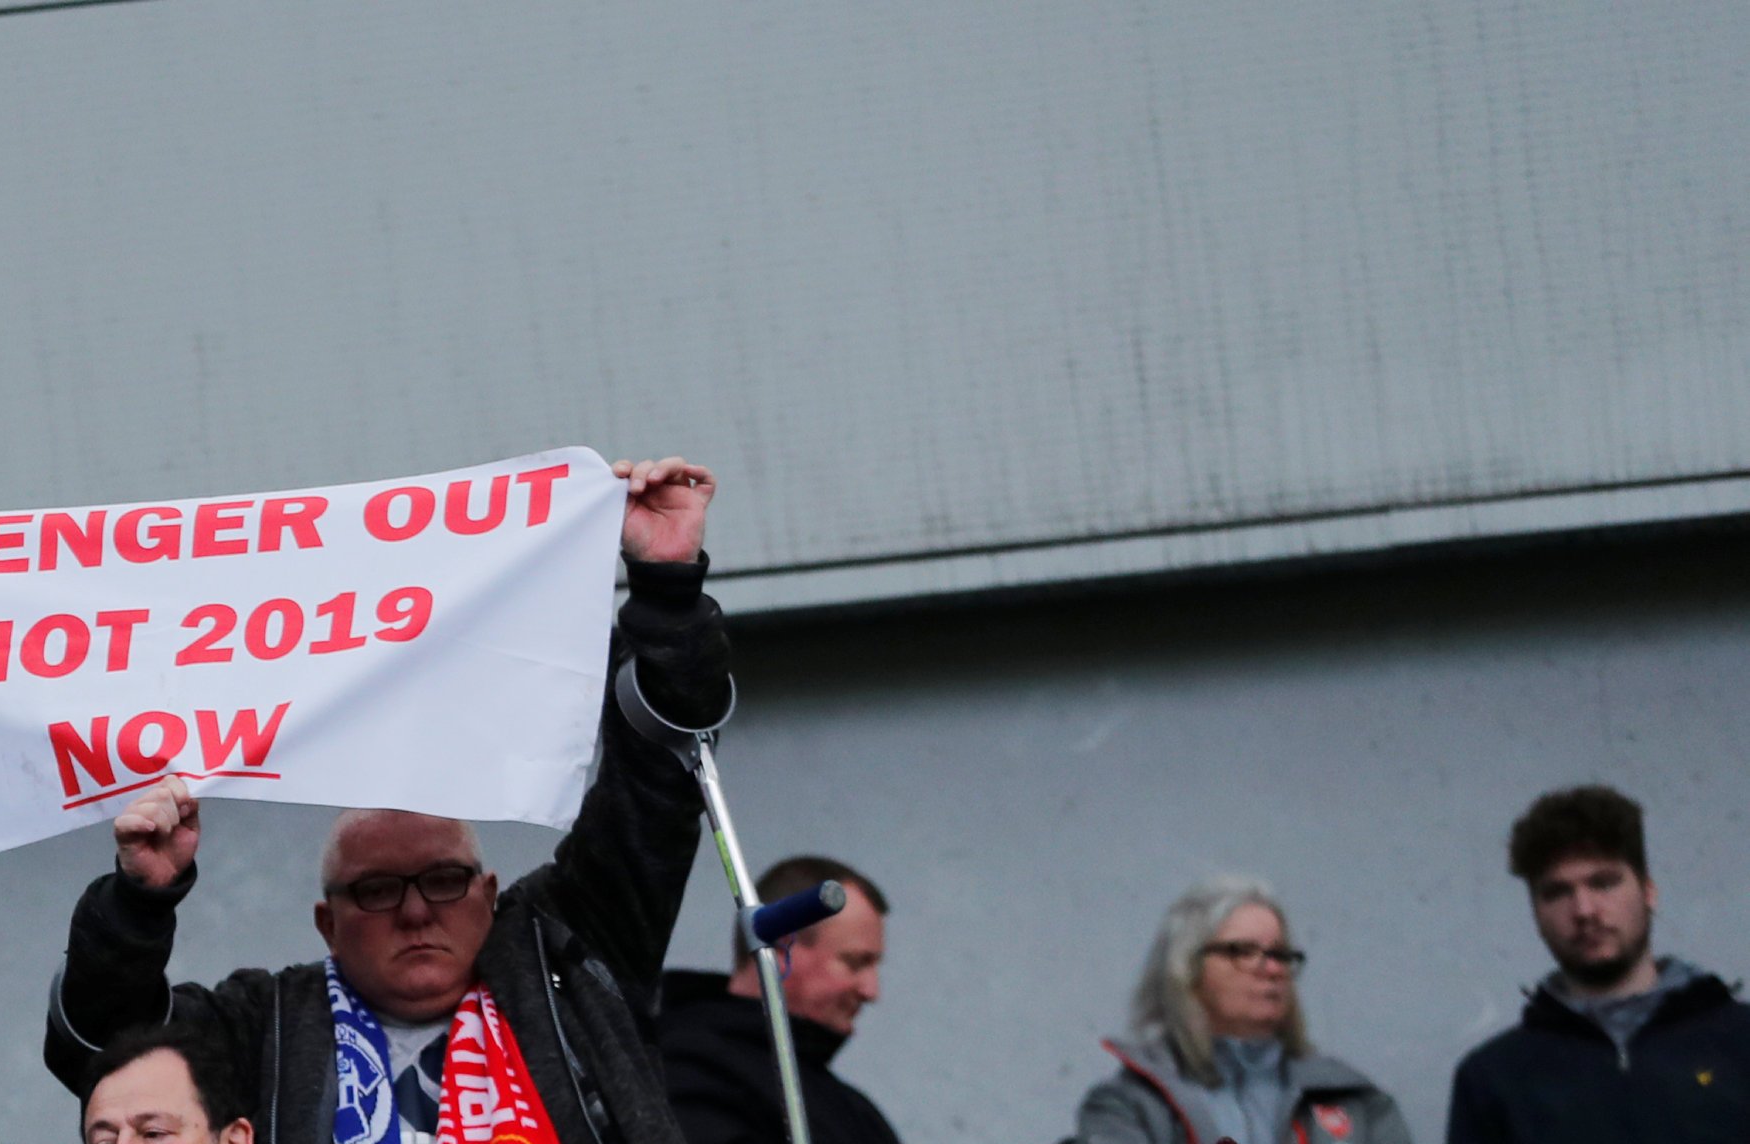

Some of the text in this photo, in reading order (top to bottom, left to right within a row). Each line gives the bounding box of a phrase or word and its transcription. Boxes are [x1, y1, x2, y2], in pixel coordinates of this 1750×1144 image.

[363, 463, 570, 543] OUT
[175, 585, 434, 667] 2019
[48, 701, 292, 798] NOW
